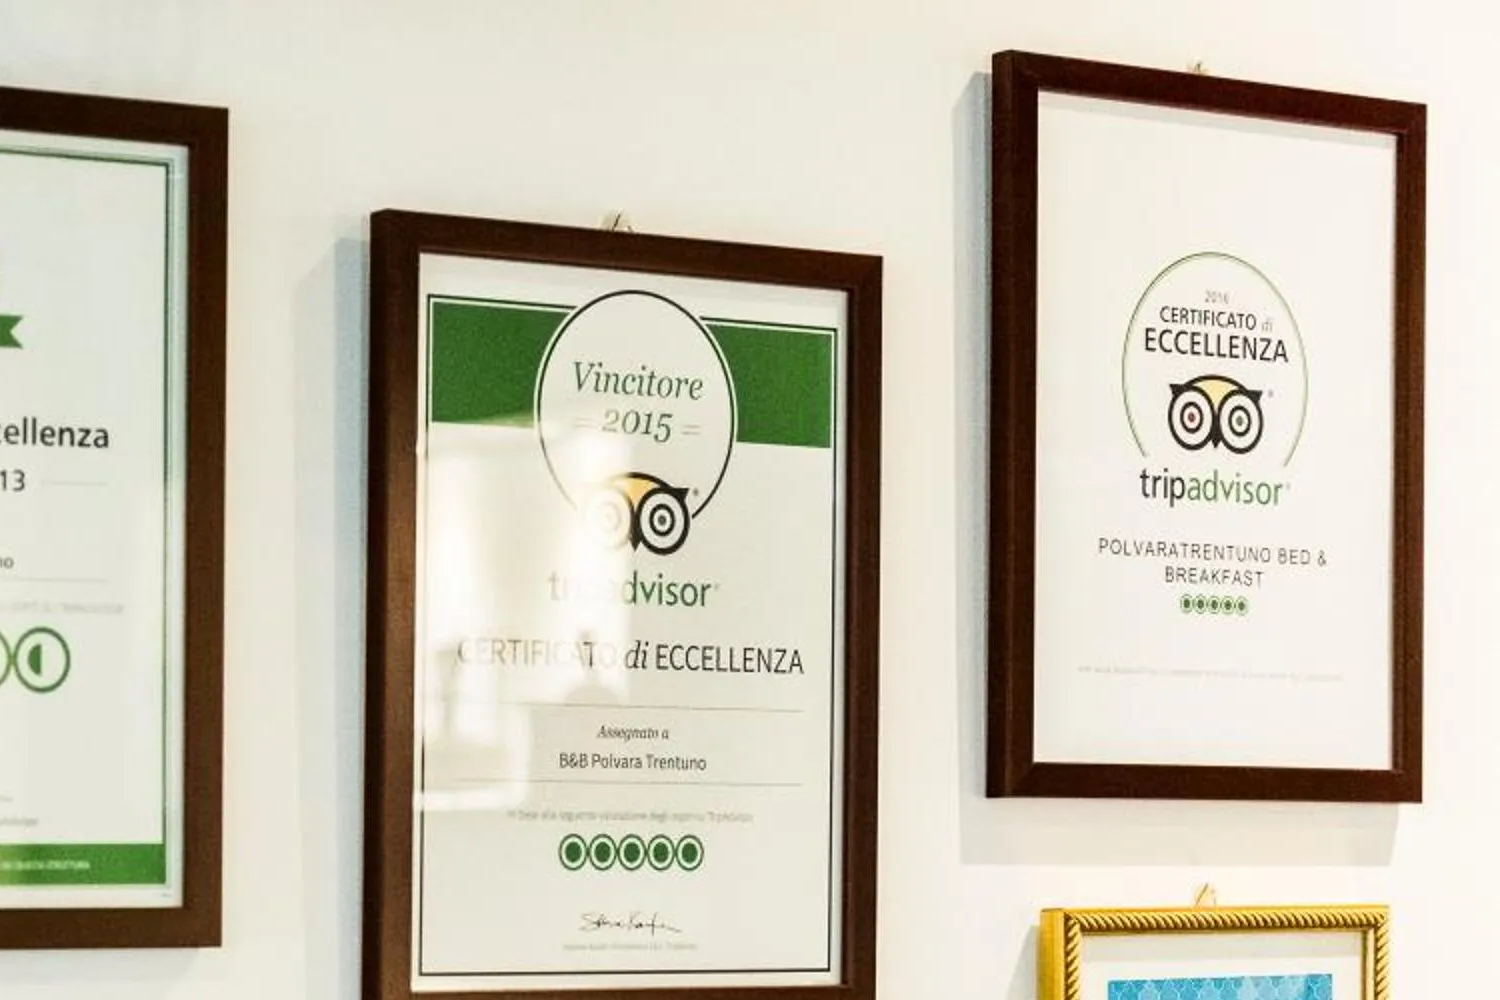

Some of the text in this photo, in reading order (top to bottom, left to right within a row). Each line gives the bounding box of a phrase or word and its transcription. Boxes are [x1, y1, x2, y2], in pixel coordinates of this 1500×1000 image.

[1159, 305, 1257, 331] CERTIFICATO
[1144, 327, 1289, 363] ECCELLENZA
[572, 360, 704, 401] Vincitore
[600, 408, 674, 443] 2015
[1139, 467, 1283, 508] tripadvisor
[1098, 537, 1328, 568] POLVARATRENTUNO BED &
[547, 569, 712, 607] tdvisor
[1165, 565, 1265, 587] BREAKFAST
[625, 640, 650, 671] di
[656, 643, 804, 675] ECCELLENZA
[596, 725, 659, 743] Assegnato
[558, 752, 708, 772] B&B Polvara Trentuno
